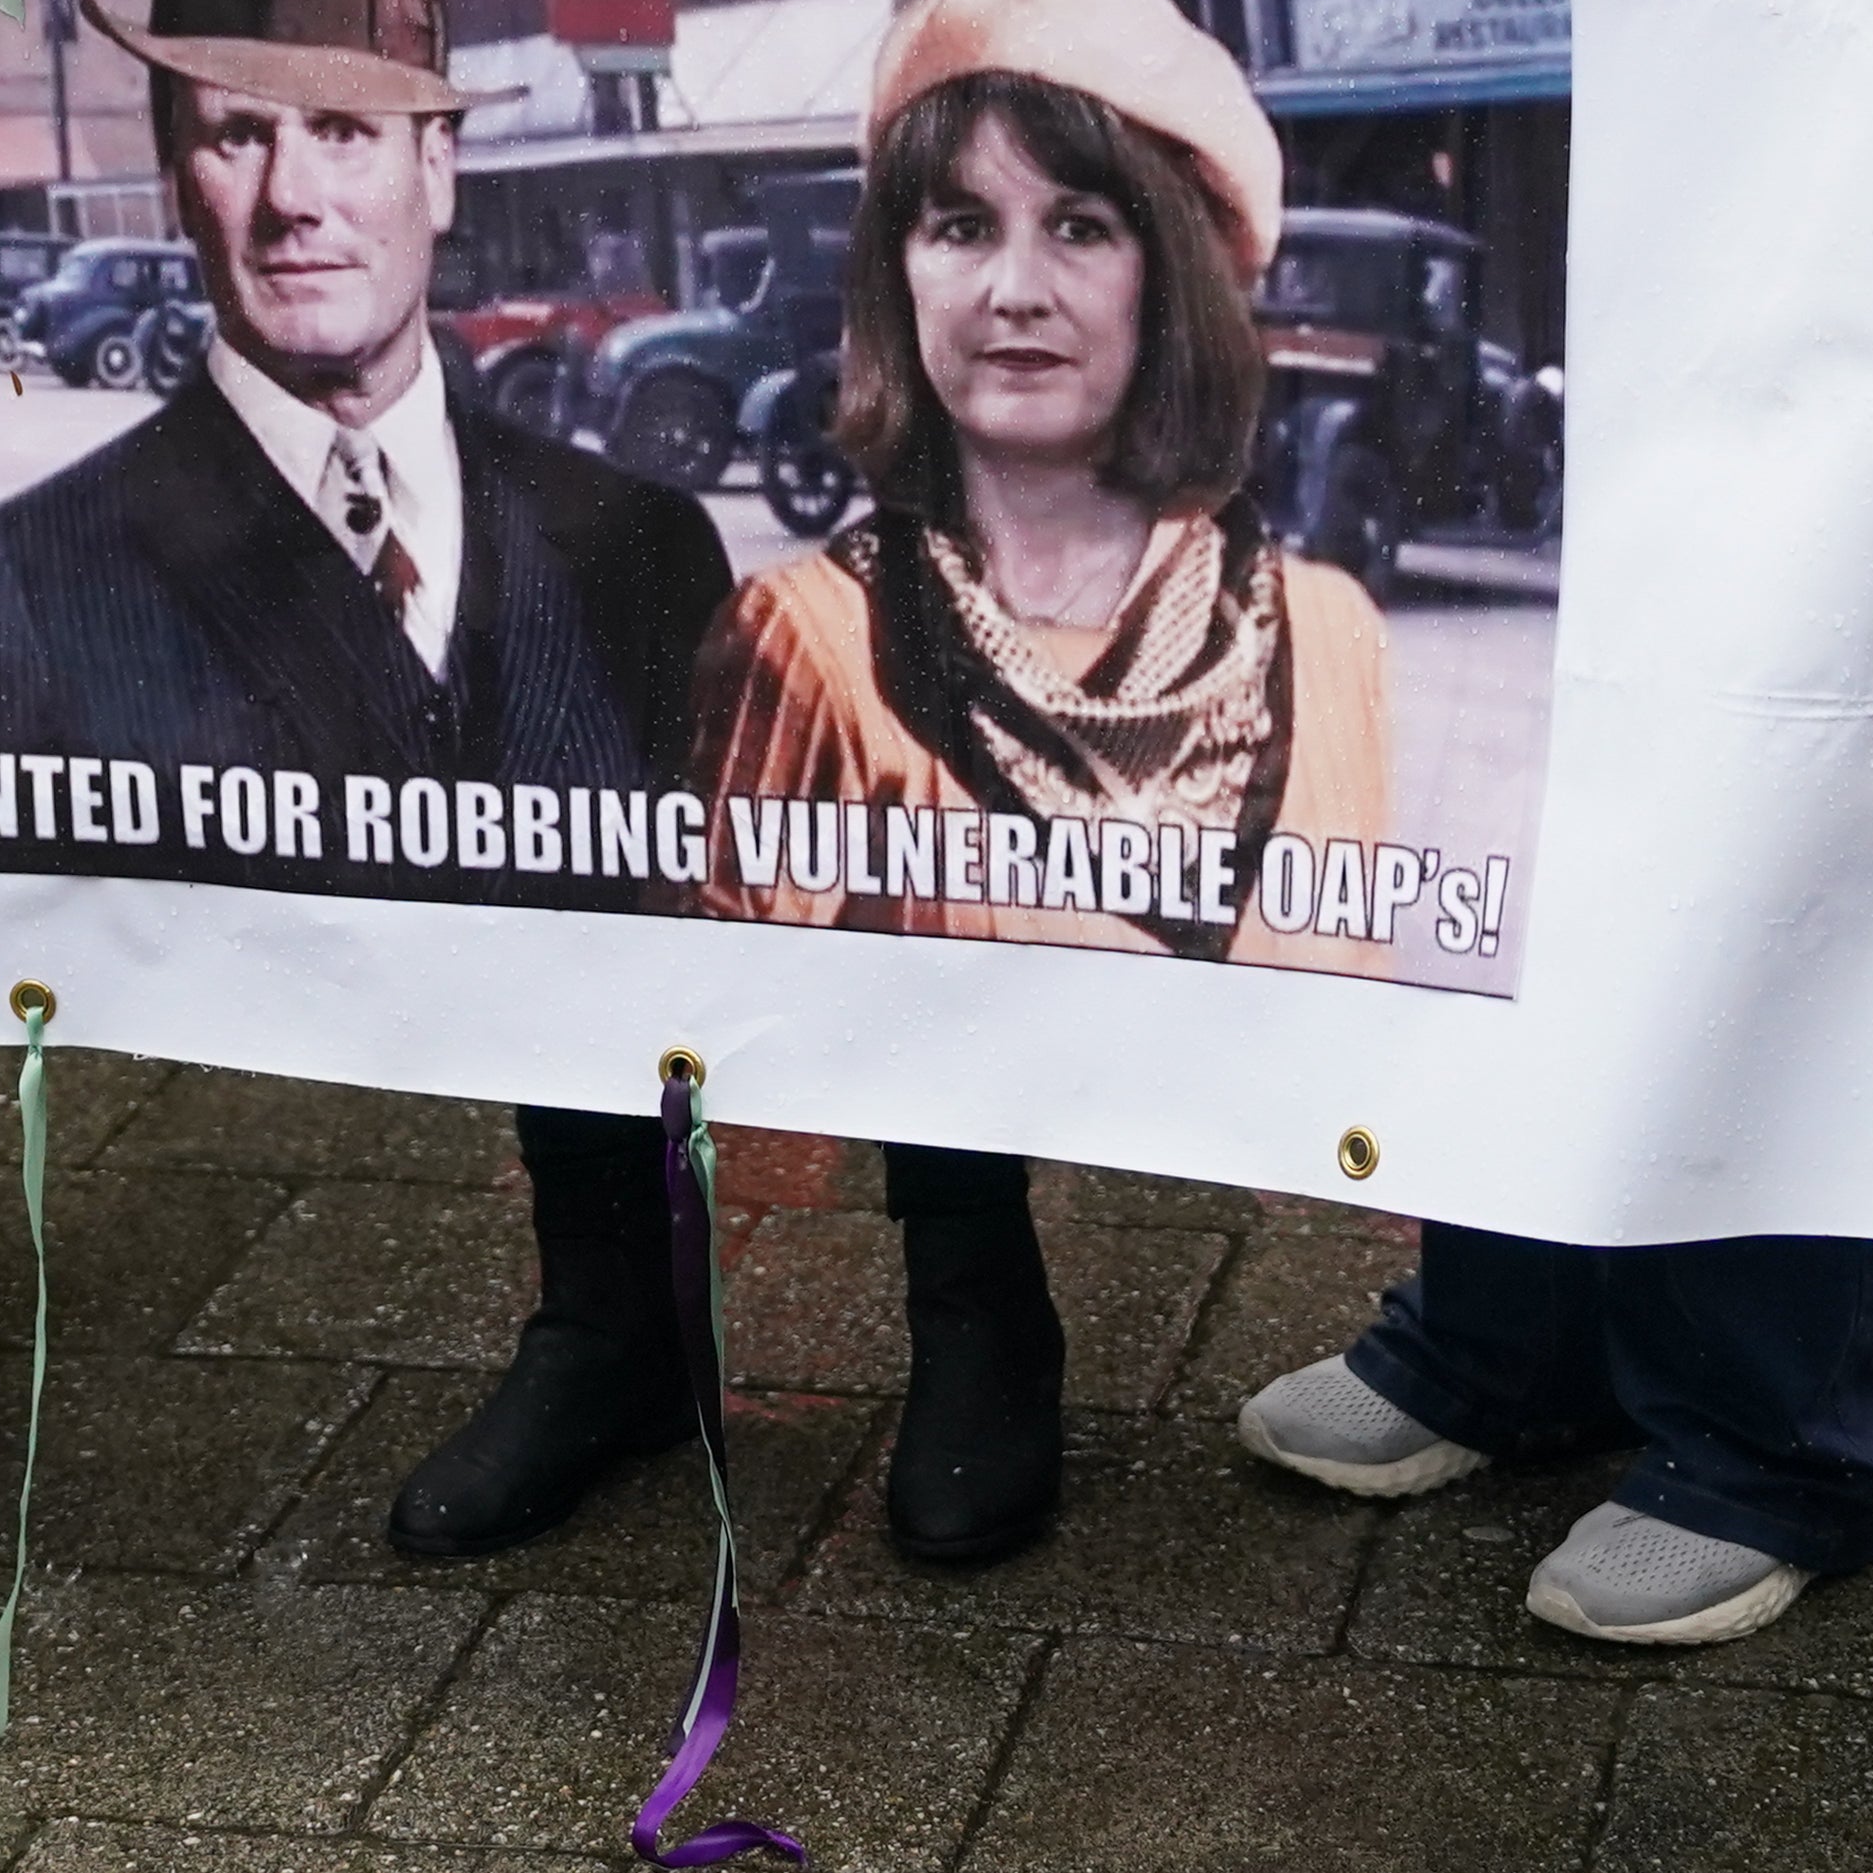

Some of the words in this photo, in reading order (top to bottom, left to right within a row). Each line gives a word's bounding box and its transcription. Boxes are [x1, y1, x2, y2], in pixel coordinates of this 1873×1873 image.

[180, 764, 323, 859] FOR
[344, 774, 709, 884] ROBBING
[728, 792, 1238, 926] VULNERABLE
[1258, 834, 1512, 959] OAP's!
